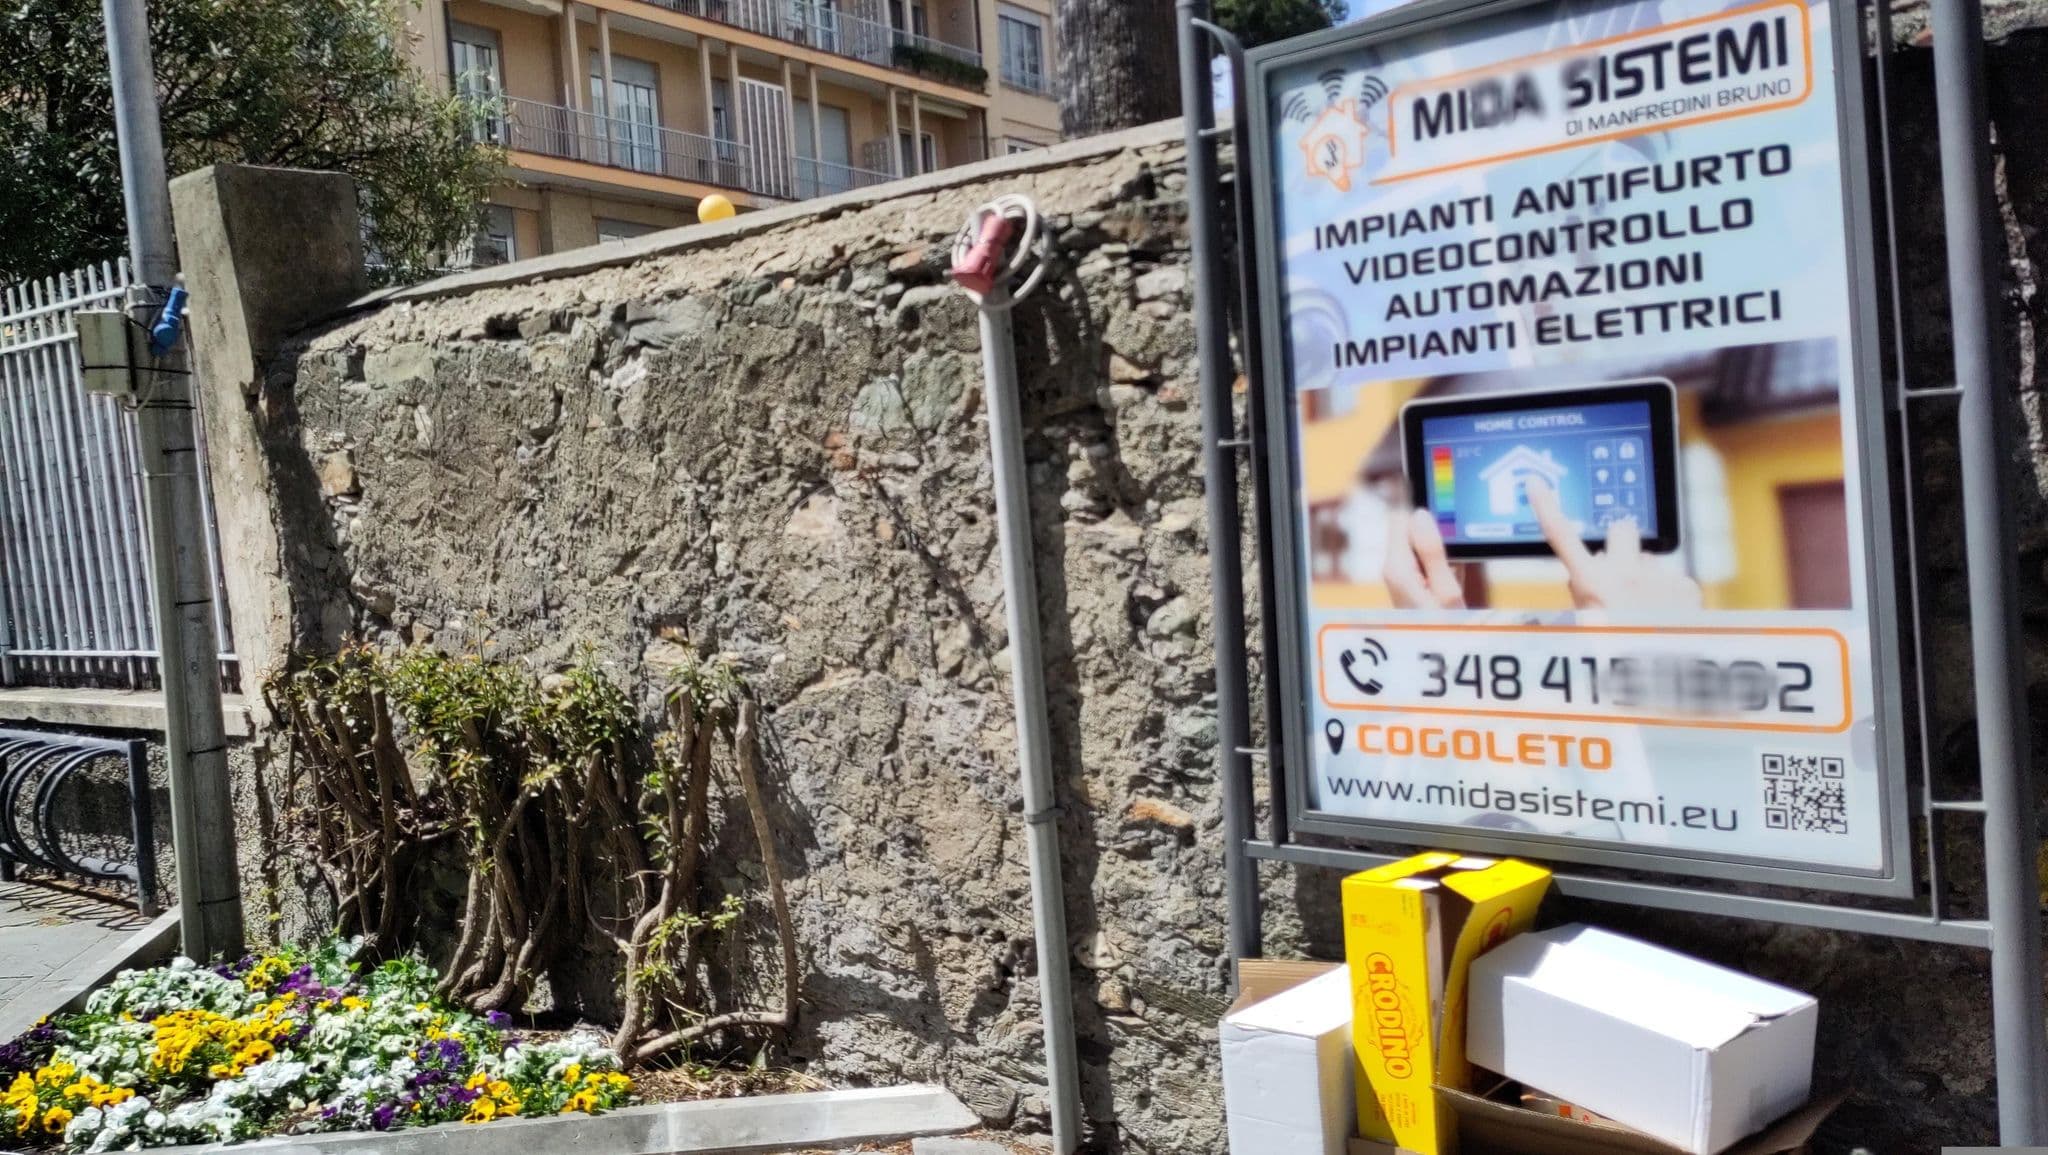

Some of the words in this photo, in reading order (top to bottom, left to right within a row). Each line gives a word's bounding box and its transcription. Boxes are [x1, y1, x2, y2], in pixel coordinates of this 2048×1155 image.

[1561, 15, 1789, 109] SISTEMI
[1566, 119, 1584, 136] DI
[1587, 94, 1711, 132] MANFREDINI
[1716, 78, 1791, 107] BRUNO
[1315, 193, 1494, 250] IMPIANTI
[1511, 143, 1792, 219] ANTIFURTO
[1344, 197, 1754, 285] VIDEOCONTROLLO
[1385, 251, 1704, 321] AUTOMAZIONI
[1334, 310, 1516, 367] IMPIANTI
[1536, 290, 1781, 346] ELETTRICI
[1474, 418, 1513, 432] HOME
[1518, 413, 1585, 428] CONTROL
[1419, 652, 1523, 702] 348
[1357, 724, 1613, 770] COGOLETO
[1327, 774, 1738, 832] www.midasistemi.eu
[1366, 952, 1412, 1079] CRODINO
